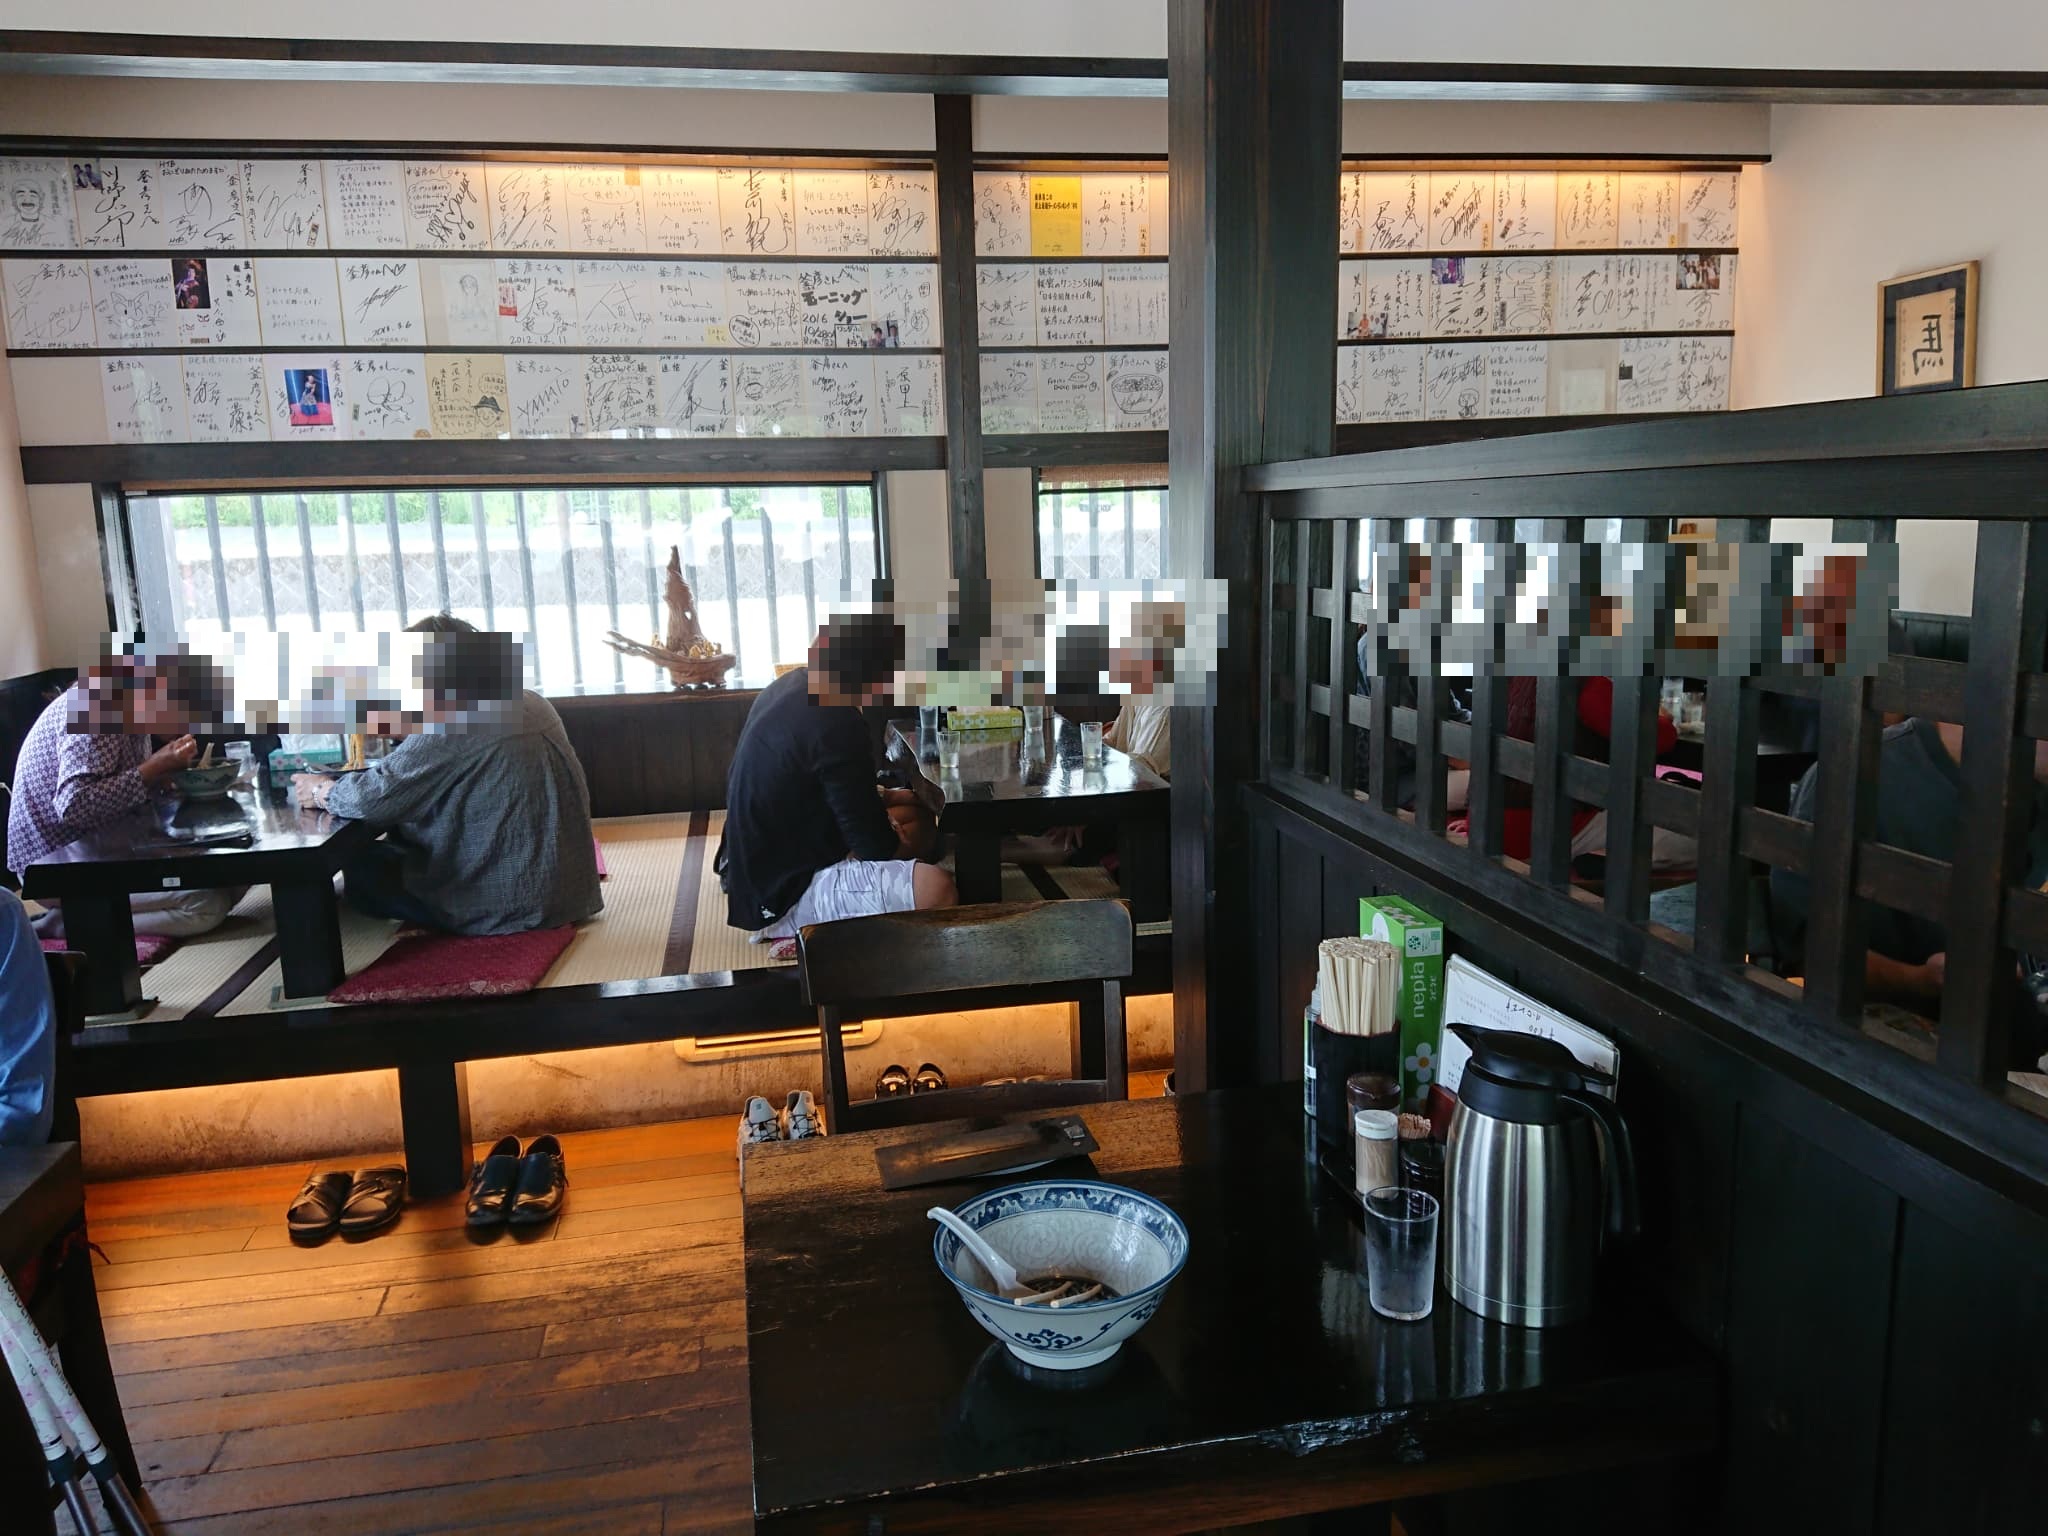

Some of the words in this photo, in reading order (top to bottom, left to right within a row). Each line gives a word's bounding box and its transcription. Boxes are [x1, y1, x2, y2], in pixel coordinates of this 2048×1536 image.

[801, 288, 868, 307] モーニング
[802, 313, 829, 324] 2016
[834, 310, 868, 324] ショー
[1413, 962, 1427, 1018] nepia
